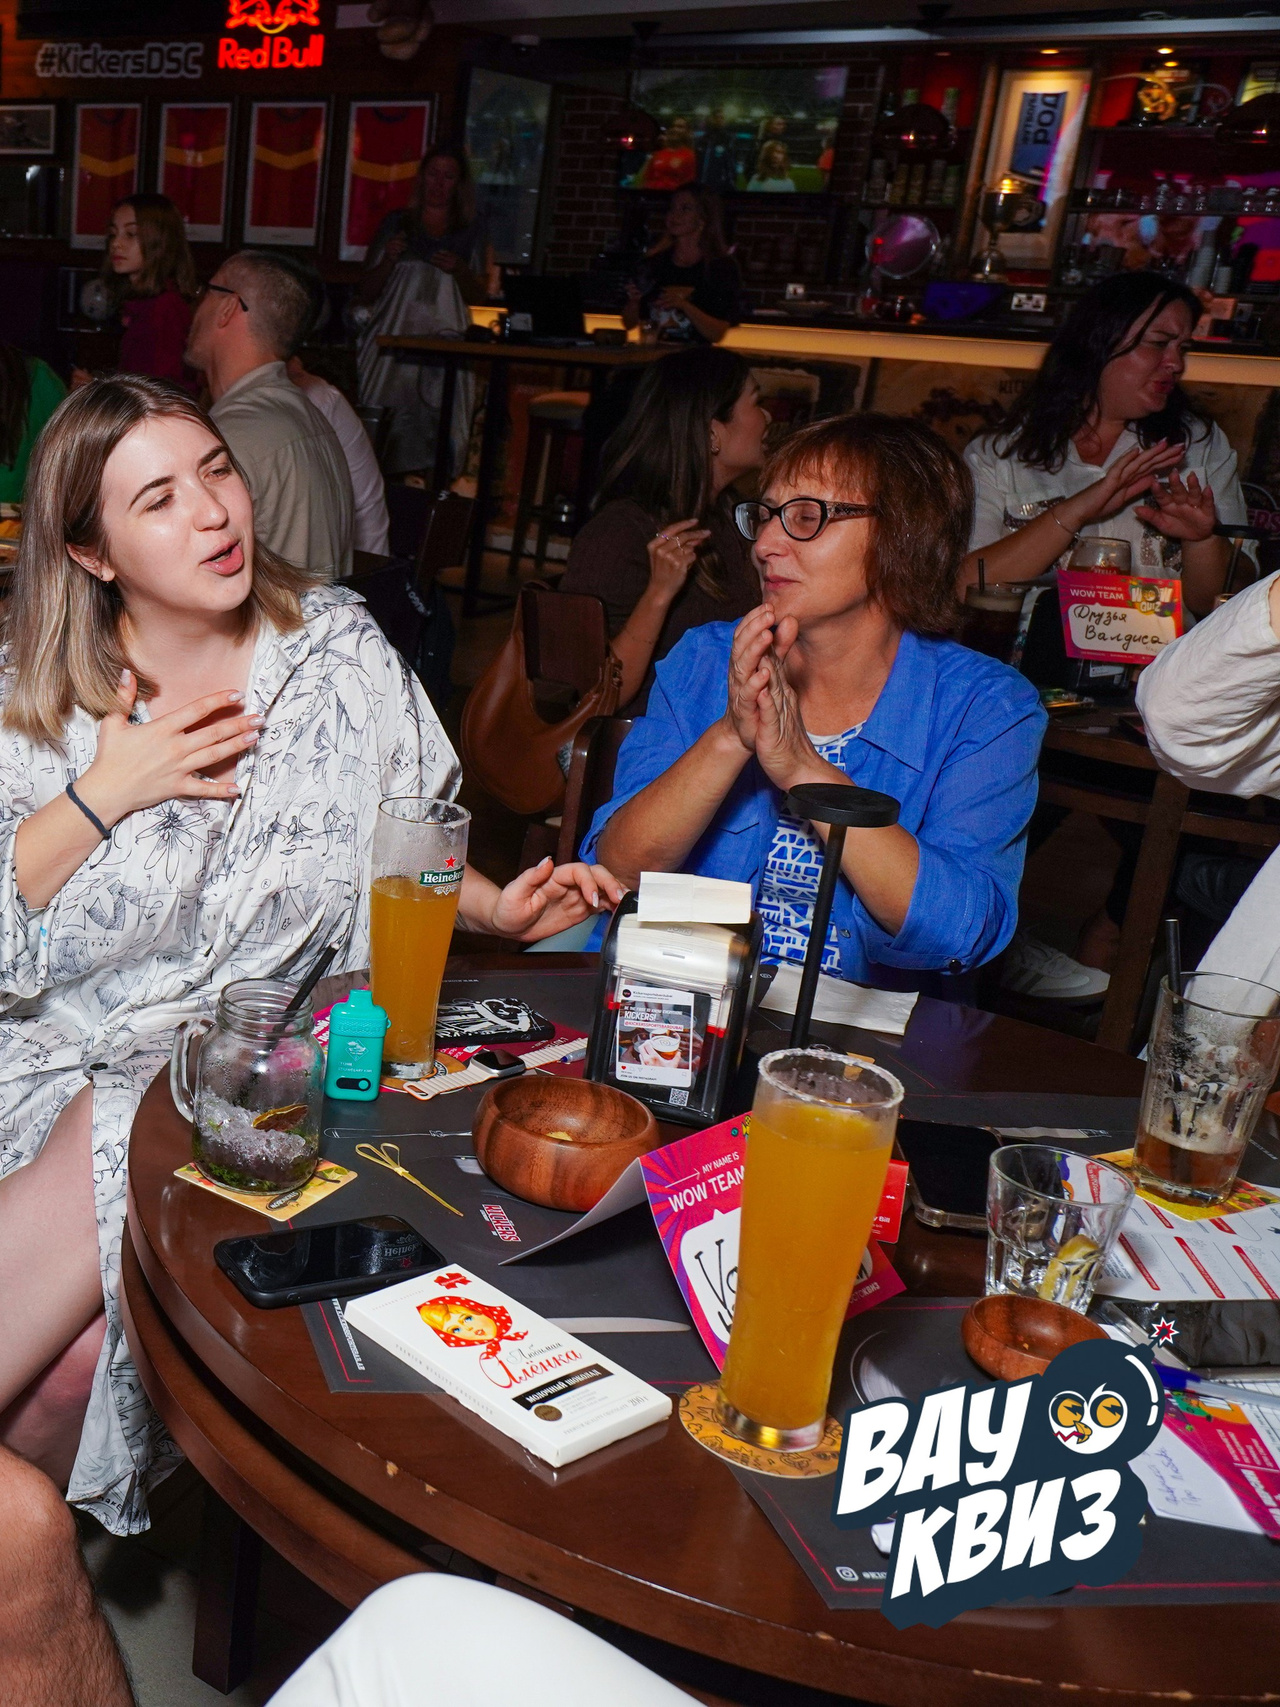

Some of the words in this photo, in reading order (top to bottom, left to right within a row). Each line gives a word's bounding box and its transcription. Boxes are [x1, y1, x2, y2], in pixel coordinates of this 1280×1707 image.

[37, 42, 203, 76] #KickersDSC
[218, 36, 269, 69] Red
[272, 34, 325, 68] Bull
[1070, 589, 1096, 598] WOW
[1097, 591, 1124, 600] TEAM
[1141, 601, 1162, 615] QUIZ
[624, 1011, 657, 1021] KICKERS!
[701, 1164, 712, 1174] MY
[712, 1157, 731, 1171] NAME
[731, 1151, 740, 1161] IS
[668, 1182, 708, 1212] WOW
[482, 1204, 521, 1242] KICKERS
[479, 1349, 583, 1389] Алёнка
[525, 1381, 568, 1404] МОЛОЧНЫЙ
[564, 1368, 602, 1389] ШОКОЛАД
